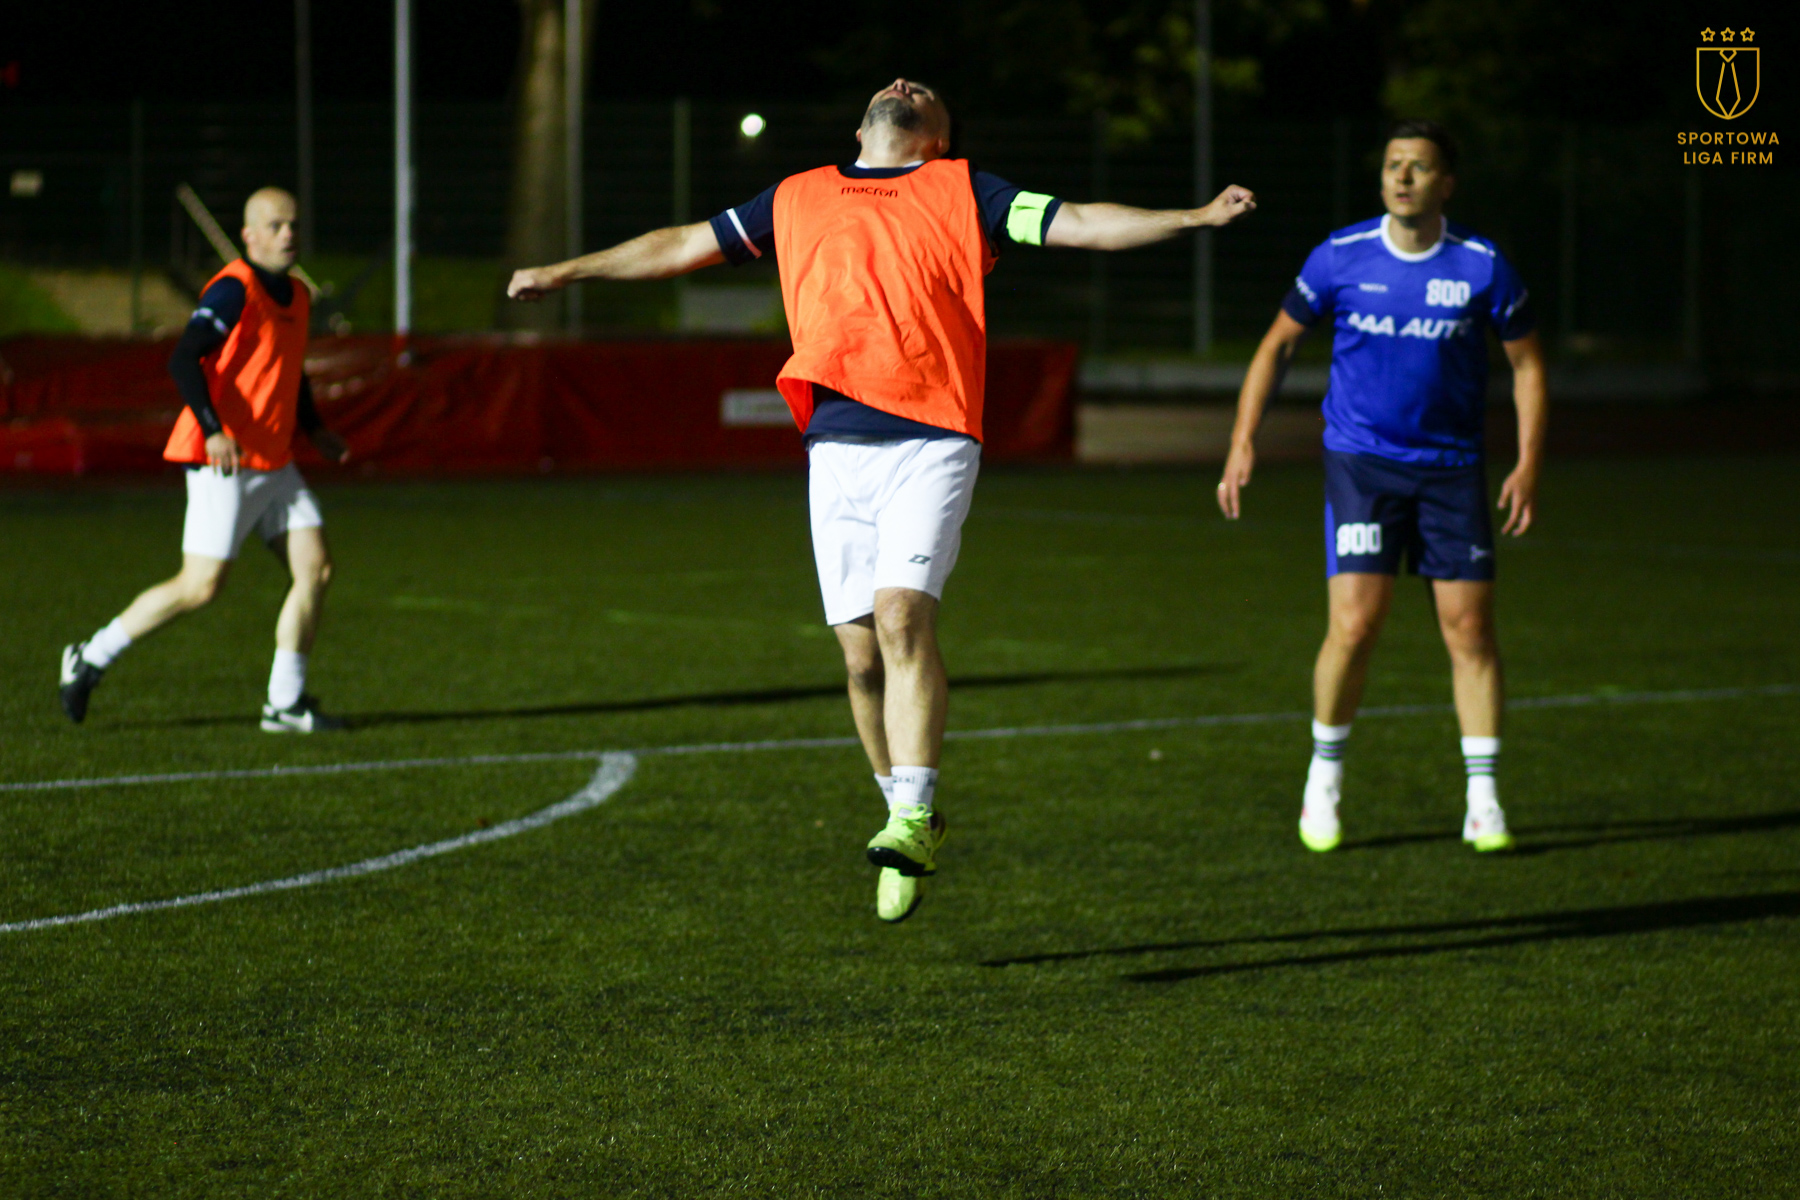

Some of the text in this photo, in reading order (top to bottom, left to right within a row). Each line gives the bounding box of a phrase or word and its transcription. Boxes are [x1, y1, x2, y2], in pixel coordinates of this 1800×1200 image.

[841, 185, 898, 198] macron
[1425, 277, 1471, 308] 800
[1347, 312, 1397, 338] AAA
[1336, 522, 1383, 557] 800
